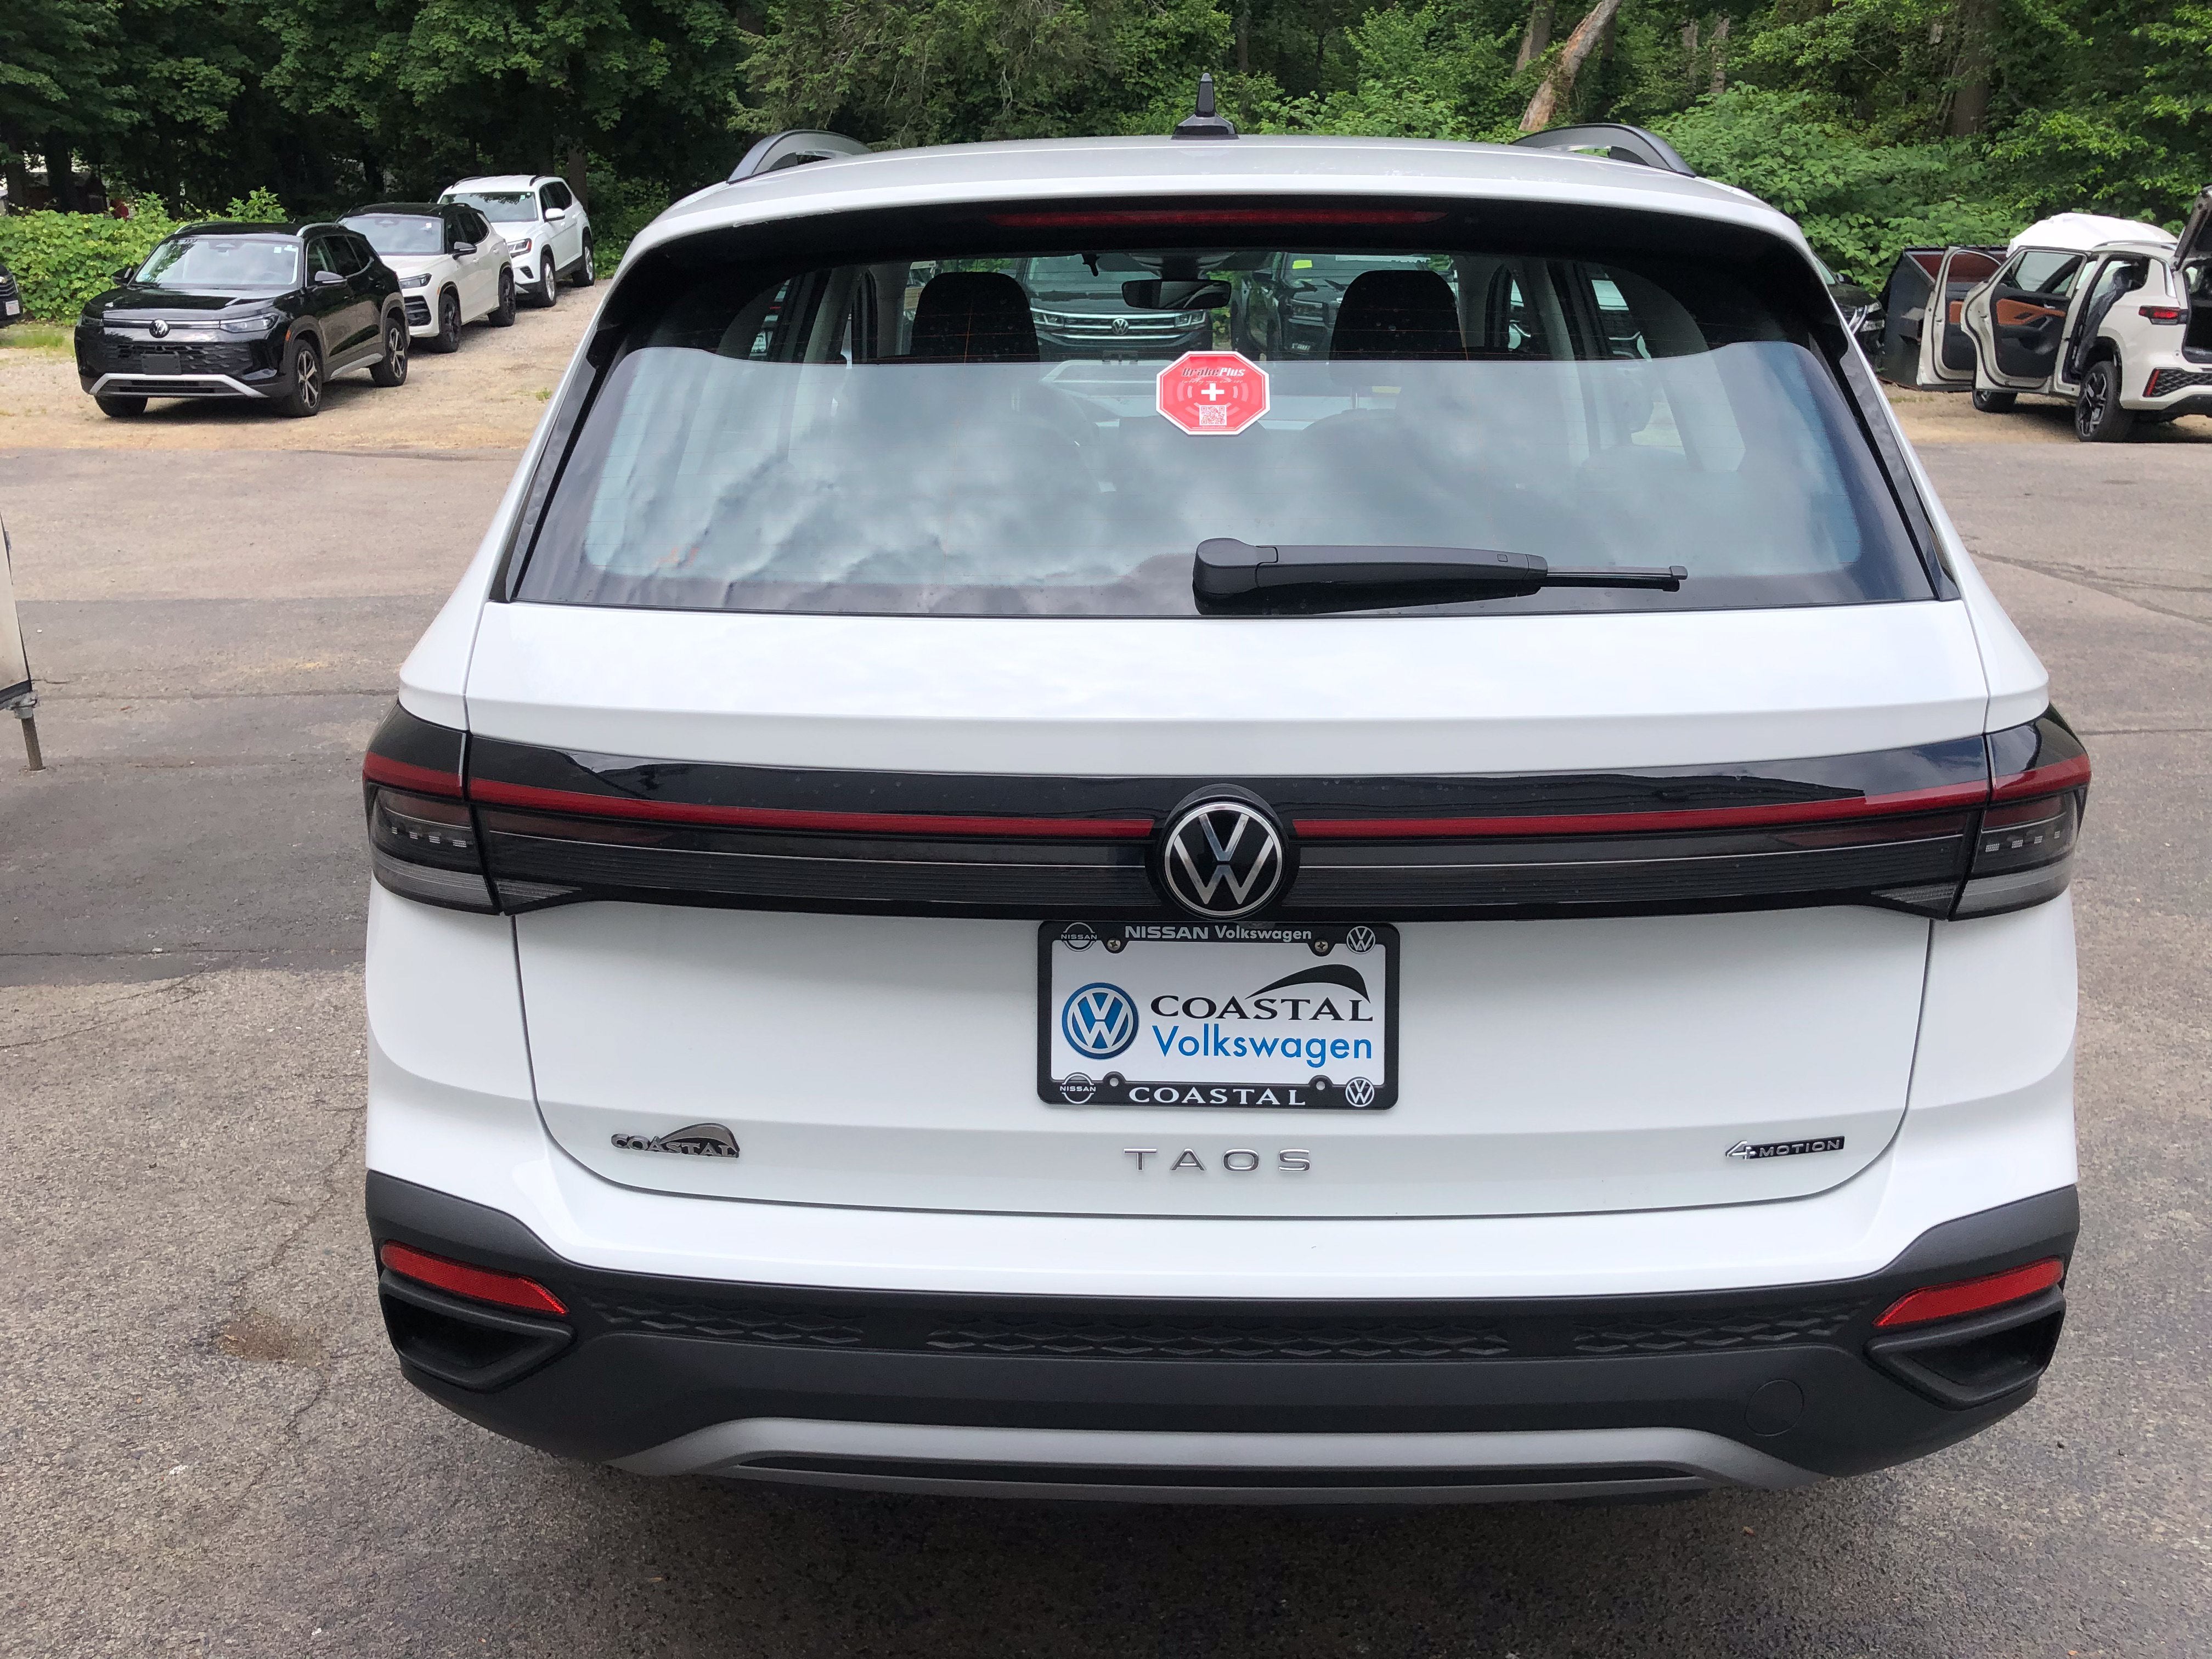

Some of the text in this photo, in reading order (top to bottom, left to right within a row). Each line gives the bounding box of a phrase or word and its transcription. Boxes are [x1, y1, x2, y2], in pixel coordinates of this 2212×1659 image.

[1182, 367, 1245, 377] BrakePlus
[1171, 810, 1277, 908] VW
[1125, 925, 1312, 943] NISSAN Volkswagen
[1347, 927, 1375, 953] VW
[1068, 988, 1133, 1054] VW
[1150, 995, 1373, 1022] COASTAL
[1152, 1024, 1372, 1068] Volkswagen
[1129, 1087, 1306, 1105] COASTAL
[1347, 1079, 1374, 1106] VW
[611, 1133, 739, 1158] COASTAL
[1725, 1139, 1839, 1160] 4MOTION
[1124, 1148, 1311, 1172] TAOS
